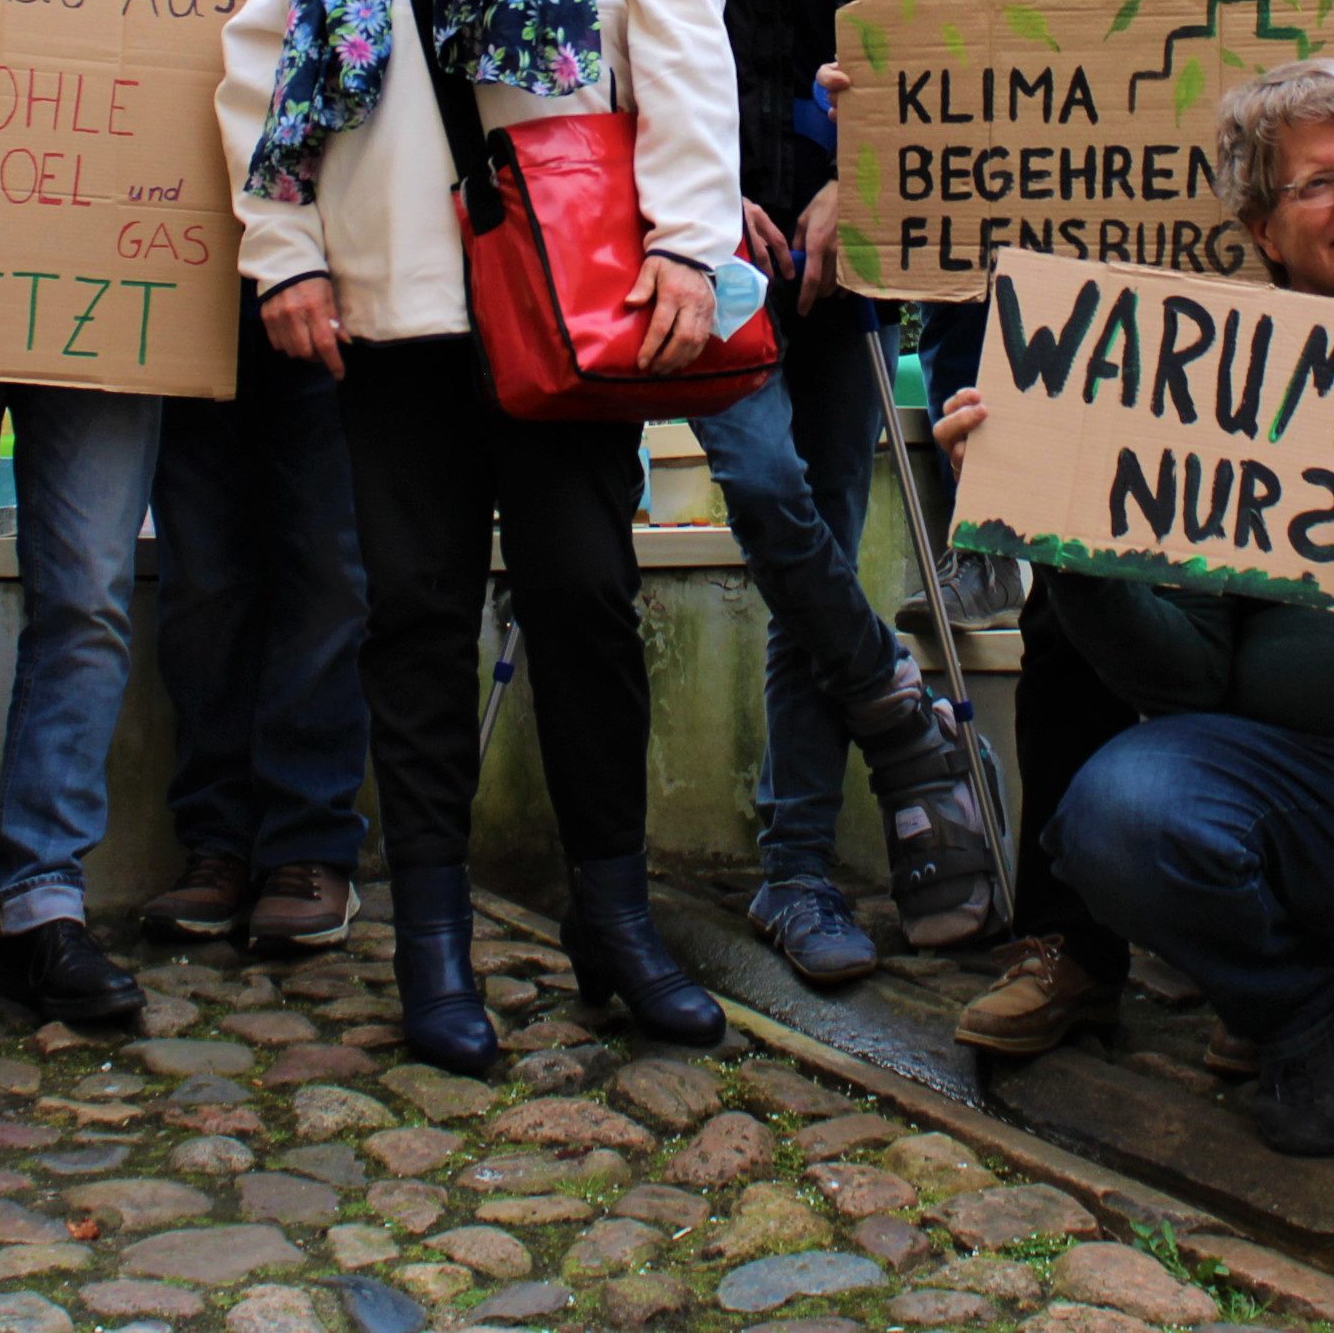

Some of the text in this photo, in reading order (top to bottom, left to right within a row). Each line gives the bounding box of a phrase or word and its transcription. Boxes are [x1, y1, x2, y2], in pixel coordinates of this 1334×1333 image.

[898, 66, 1099, 125] KLIMA
[0, 148, 184, 207] OEL und
[899, 145, 1219, 202] BEGEHREN
[117, 220, 210, 266] GAS
[900, 216, 1246, 277] FLENSBURG
